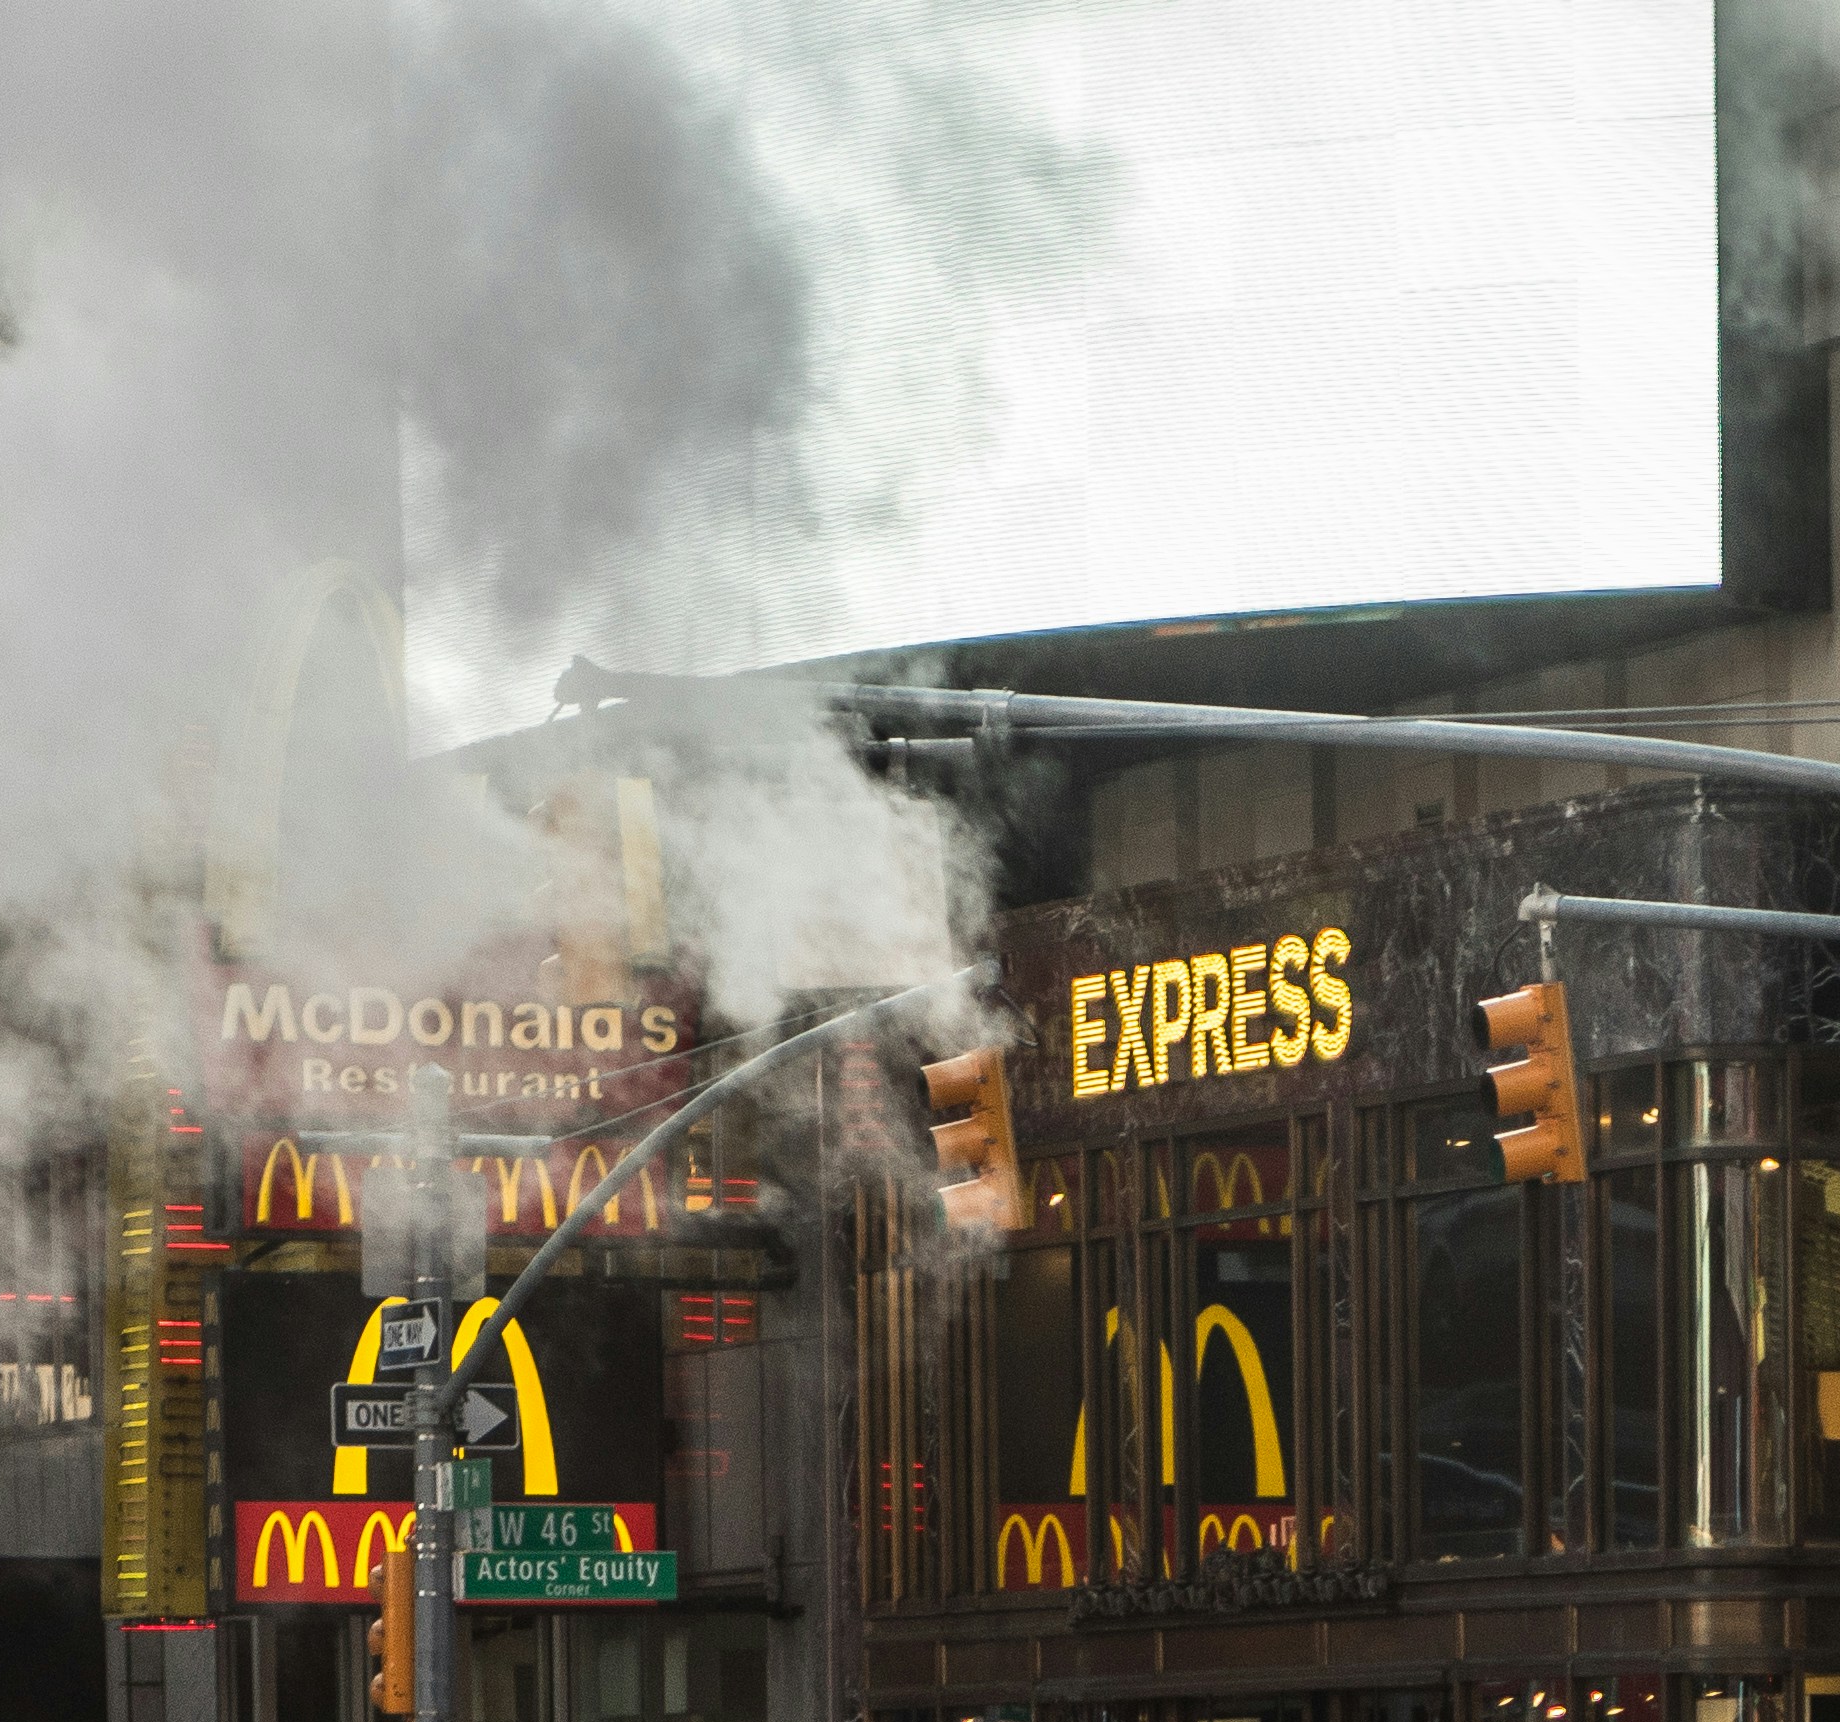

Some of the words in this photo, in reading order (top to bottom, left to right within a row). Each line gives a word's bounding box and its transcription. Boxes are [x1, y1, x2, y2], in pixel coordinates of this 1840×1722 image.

[1071, 926, 1352, 1098] EXPRESS
[301, 1057, 602, 1100] Resturant
[355, 1403, 405, 1428] ONE
[498, 1511, 525, 1546] W
[540, 1511, 578, 1546] 46
[591, 1511, 611, 1534] St
[477, 1557, 567, 1581] Actors'
[579, 1555, 659, 1587] Equity
[544, 1582, 591, 1597] Corner
